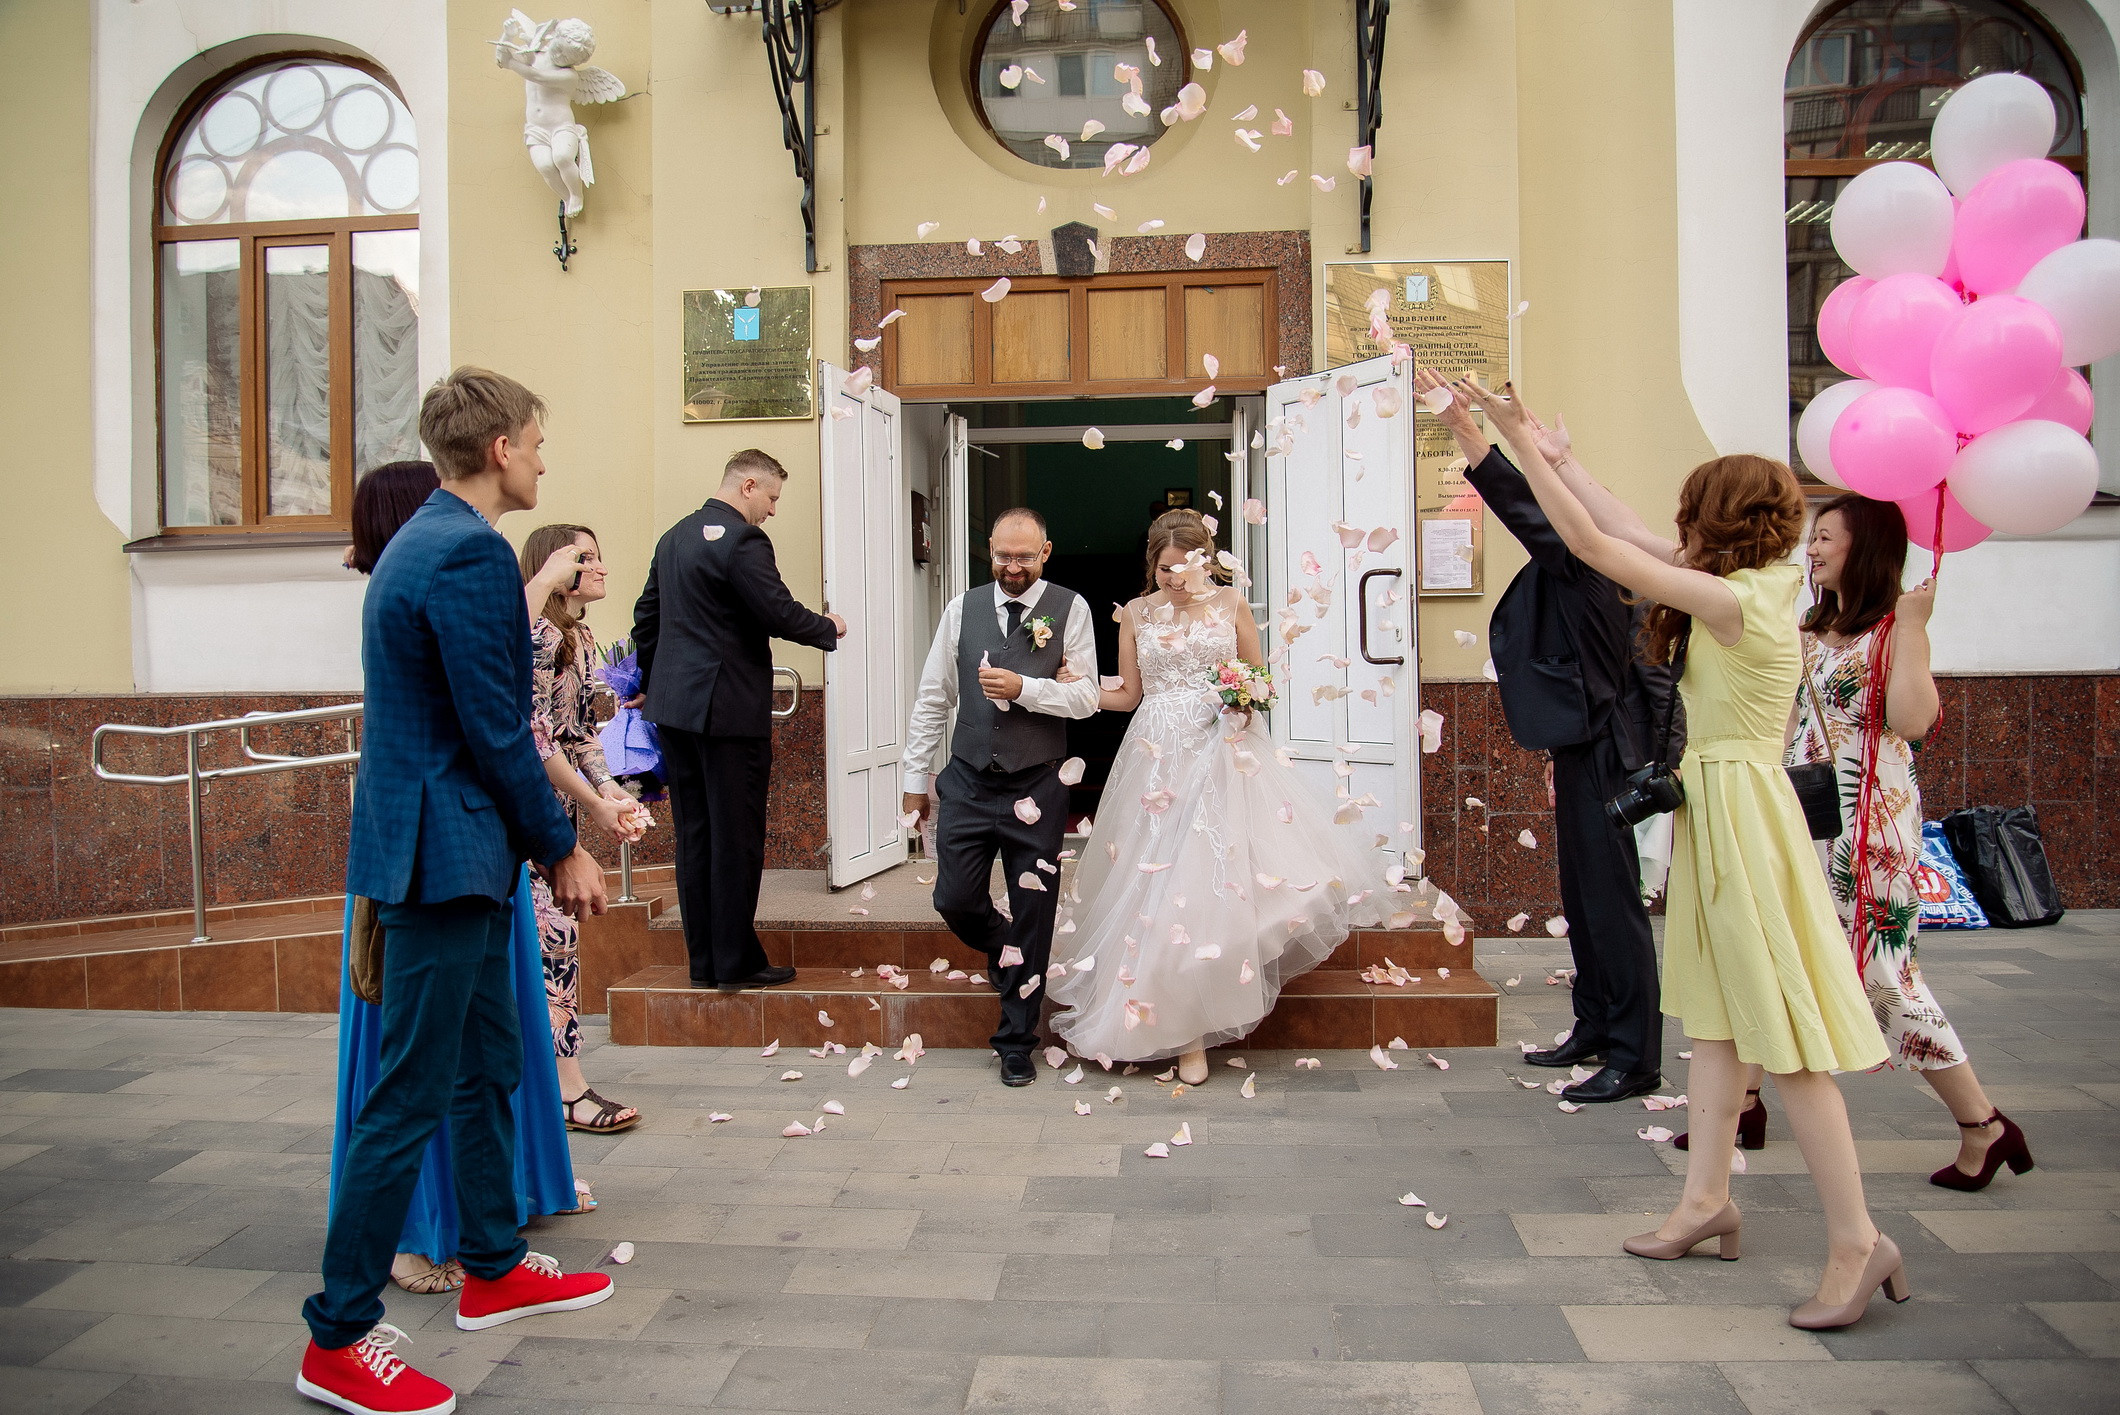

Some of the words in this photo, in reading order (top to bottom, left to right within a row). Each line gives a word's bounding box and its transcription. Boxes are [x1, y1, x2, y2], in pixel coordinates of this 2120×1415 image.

[1386, 314, 1447, 324] Управление
[1453, 342, 1479, 350] ОТДЕЛ
[1430, 349, 1485, 358] РЕГИСТРАЦИИ
[1416, 450, 1454, 458] РАБОТЫ
